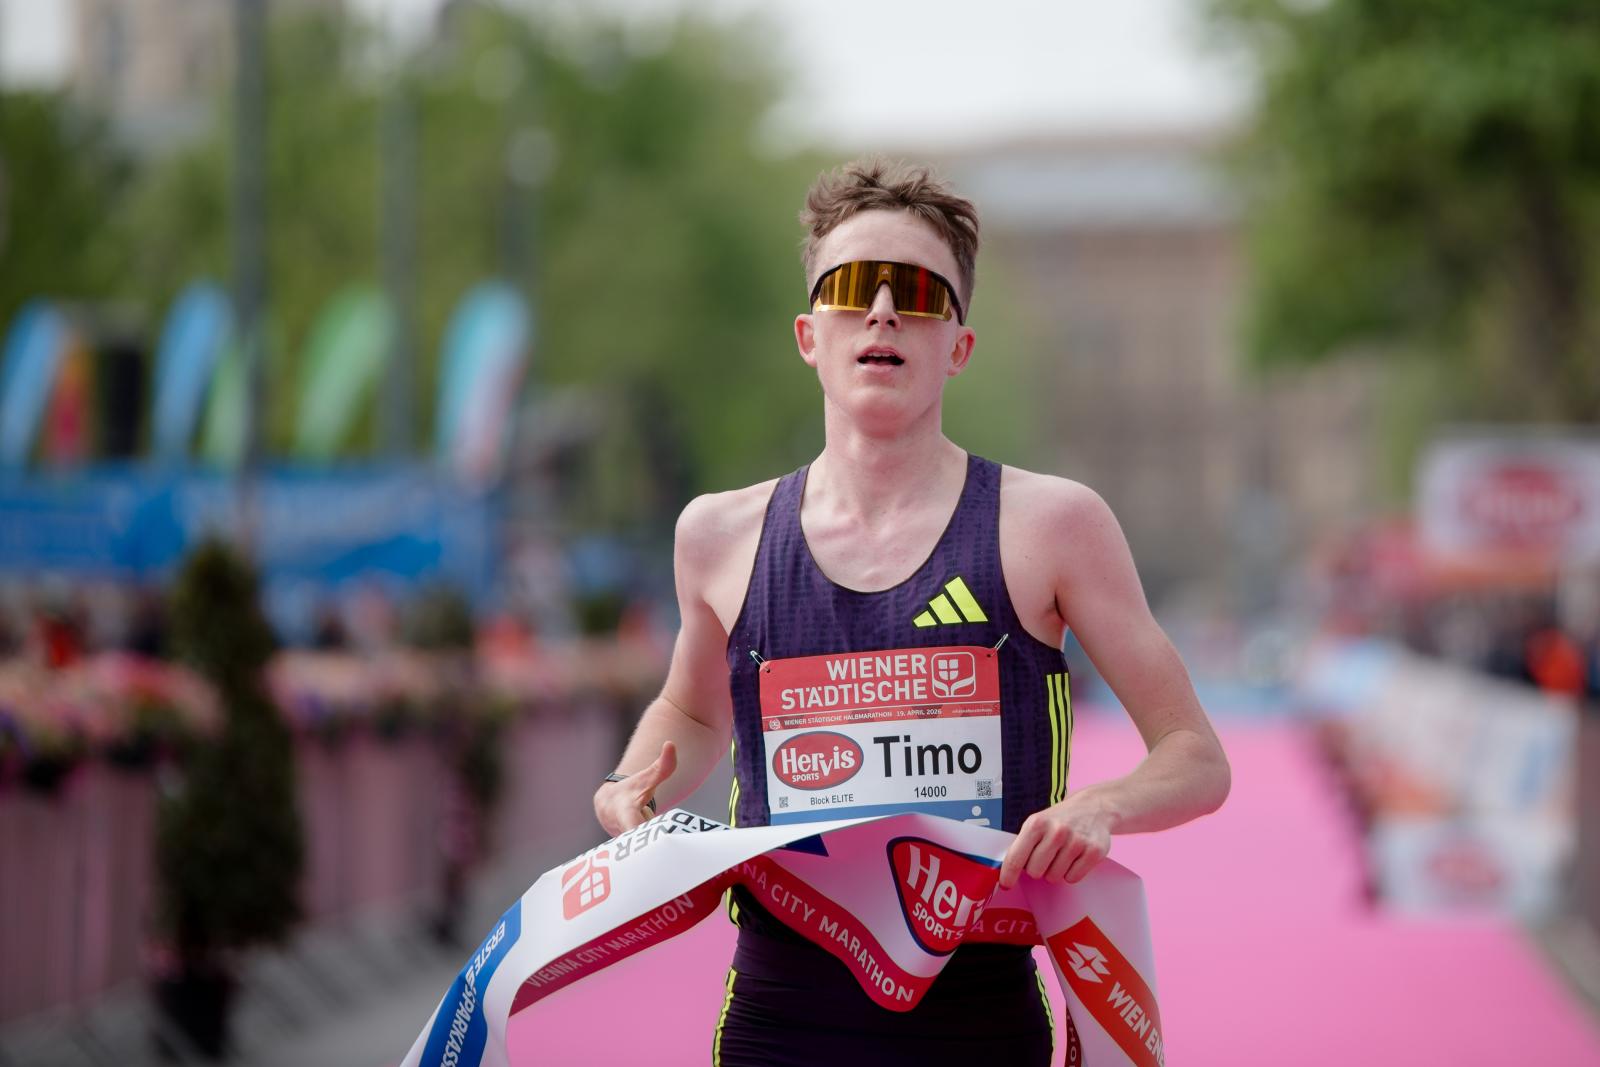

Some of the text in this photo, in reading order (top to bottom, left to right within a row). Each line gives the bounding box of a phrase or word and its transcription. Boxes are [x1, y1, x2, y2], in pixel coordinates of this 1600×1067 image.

[826, 653, 928, 681] WIENER
[780, 678, 928, 710] STÄDTISCHE
[783, 718, 807, 727] WIENER
[807, 715, 843, 725] STÄDTISCHE
[843, 711, 893, 722] HALBMARATHON
[907, 709, 925, 717] APRIL
[926, 708, 942, 716] 2026
[781, 745, 856, 777] Hervis
[873, 735, 982, 778] Timo
[791, 772, 820, 783] SPORTS
[914, 785, 947, 799] 14000
[810, 793, 854, 806] Block ELITE
[906, 843, 985, 928] Her
[912, 901, 966, 941] SPORTS
[474, 919, 506, 977] ERSTE
[526, 891, 694, 989] VIENNA CITY MARATHON
[770, 883, 817, 923] CITY
[818, 915, 915, 1003] MARATHON
[1106, 981, 1151, 1040] WIEN
